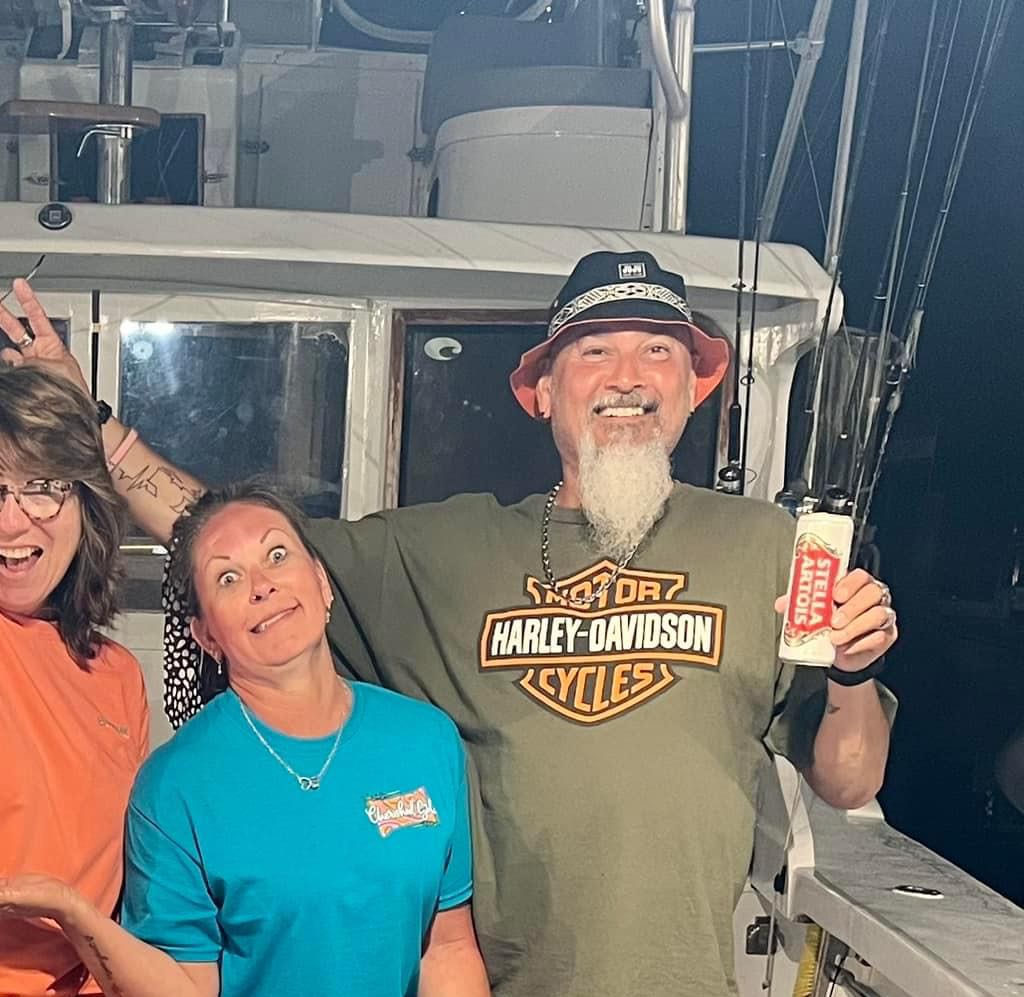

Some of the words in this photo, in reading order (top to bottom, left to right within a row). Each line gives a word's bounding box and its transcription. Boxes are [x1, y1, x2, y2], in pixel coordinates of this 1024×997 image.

[545, 571, 661, 610] MOTOR
[793, 556, 816, 626] ARTOIS
[808, 557, 832, 626] STELLA
[490, 612, 714, 657] HARLEY-DAVIDSON
[538, 662, 655, 713] CYCLES
